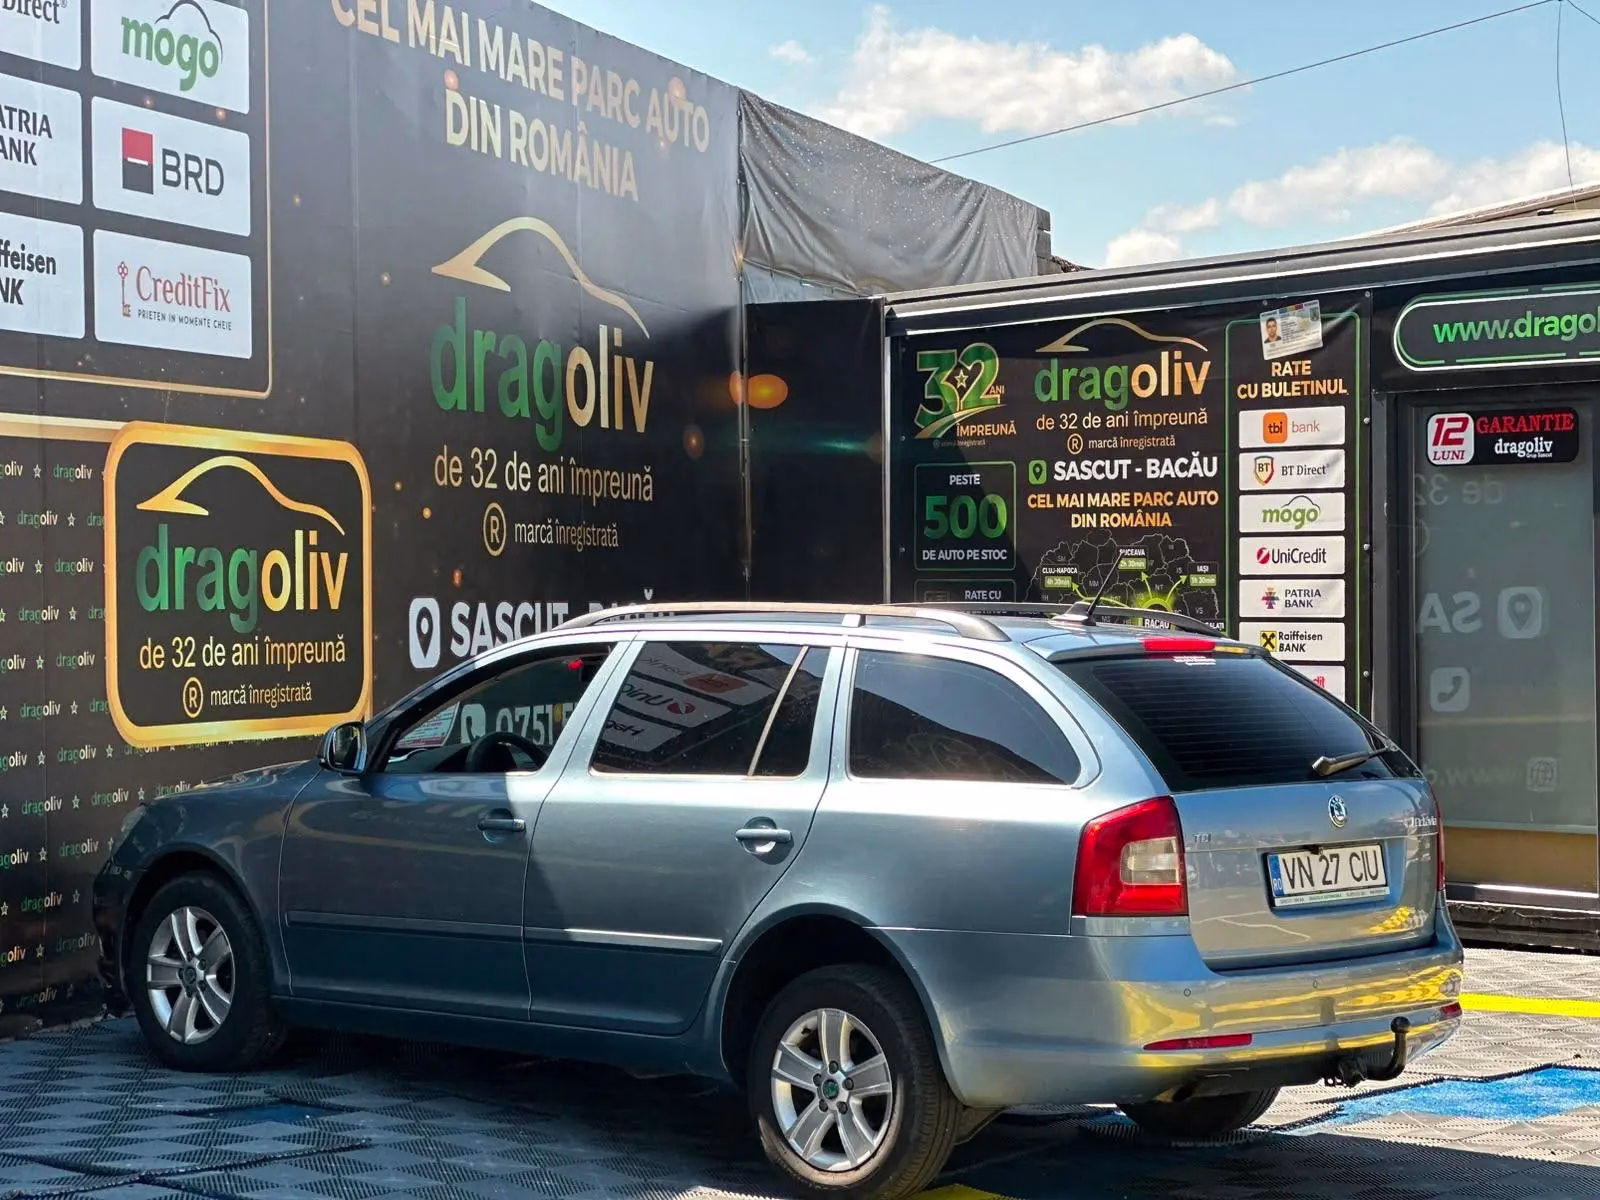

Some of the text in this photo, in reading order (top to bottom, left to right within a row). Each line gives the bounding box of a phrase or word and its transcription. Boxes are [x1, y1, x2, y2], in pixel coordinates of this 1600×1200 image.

[121, 15, 220, 91] mogo
[332, 0, 710, 153] CEL MAI MARE PARC AUTO
[445, 89, 639, 202] DIN ROMÂNIA
[162, 148, 225, 197] BRD
[136, 265, 231, 313] CreditFix
[138, 309, 232, 331] PRIETEN IN MOMENTE CHEIE
[430, 296, 654, 452] dragoliv
[1271, 360, 1312, 377] RATE
[913, 342, 1001, 432] 32
[989, 385, 1005, 395] ANI
[1034, 350, 1211, 411] dragoliv
[1237, 378, 1348, 399] CU BULETINUL
[956, 420, 1017, 437] ÎMPREUNĂ
[1036, 407, 1208, 431] de 32 de ani împreună
[1267, 420, 1320, 434] tbi bank
[1476, 413, 1575, 434] GARANTIE
[1432, 416, 1470, 447] 12
[1088, 436, 1118, 449] marcă
[1119, 434, 1176, 451] înregistrată
[1494, 436, 1553, 458] dragoliv
[1432, 450, 1465, 461] LUNI
[53, 464, 93, 482] dragoliv
[434, 445, 654, 507] de 32 de ani împreună
[1053, 459, 1131, 482] SASCUT
[1146, 452, 1218, 479] BACĂU
[1257, 463, 1270, 473] BT
[1281, 465, 1295, 476] BT
[949, 473, 981, 486] PESTE
[1027, 490, 1219, 509] CEL MAI MARE PARC AUTO
[17, 510, 58, 528] dragoliv
[923, 494, 1008, 540] 500
[1071, 509, 1172, 528] DIN ROMÂNIA
[1262, 507, 1319, 530] mogo
[514, 518, 553, 544] marcă
[555, 519, 619, 552] înregistrată
[922, 549, 1008, 561] DE AUTO PE STOC
[1271, 548, 1327, 565] UniCredit
[55, 558, 94, 576] dragoliv
[135, 523, 349, 634] dragoliv
[964, 590, 1002, 600] RATE CU
[1284, 588, 1322, 599] PATRIA
[1284, 599, 1314, 609] BANK
[19, 605, 60, 624] dragoliv
[1278, 631, 1323, 642] Raiffeisen
[139, 634, 346, 671] de 32 de ani împreună
[1278, 642, 1307, 653] BANK
[56, 651, 95, 670] dragoliv
[210, 684, 247, 706] marcă
[248, 682, 313, 709] înregistrată
[20, 700, 61, 720] dragoliv
[58, 745, 97, 764] dragoliv
[21, 796, 63, 816] dragoliv
[91, 788, 130, 807] dragoliv
[59, 838, 99, 858] dragoliv
[1282, 850, 1379, 889] VN 27 CIU
[21, 891, 63, 912] dragoliv
